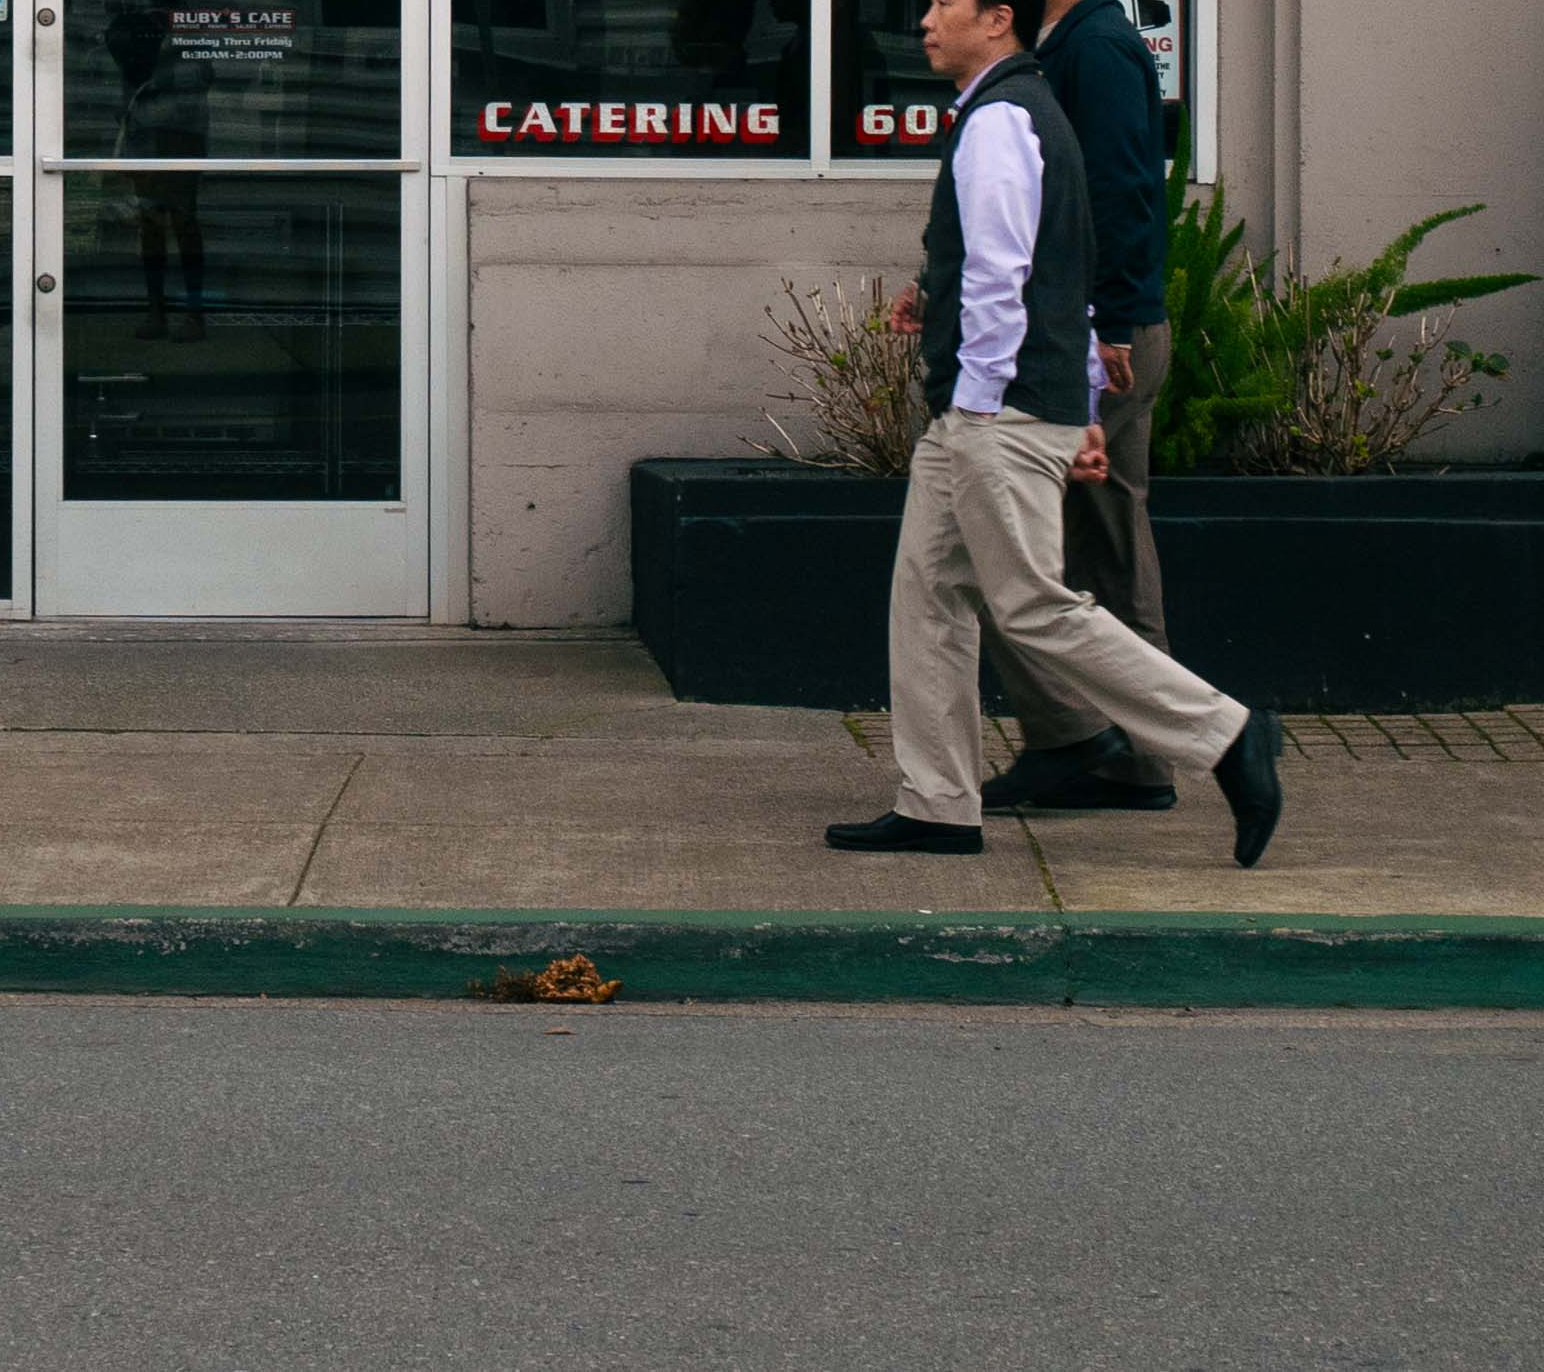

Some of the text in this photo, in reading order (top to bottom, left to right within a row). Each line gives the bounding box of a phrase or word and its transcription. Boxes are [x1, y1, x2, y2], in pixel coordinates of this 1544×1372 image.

[248, 12, 293, 24] CAFE
[171, 36, 293, 48] Monday Thru Friday
[478, 101, 780, 143] CATERING
